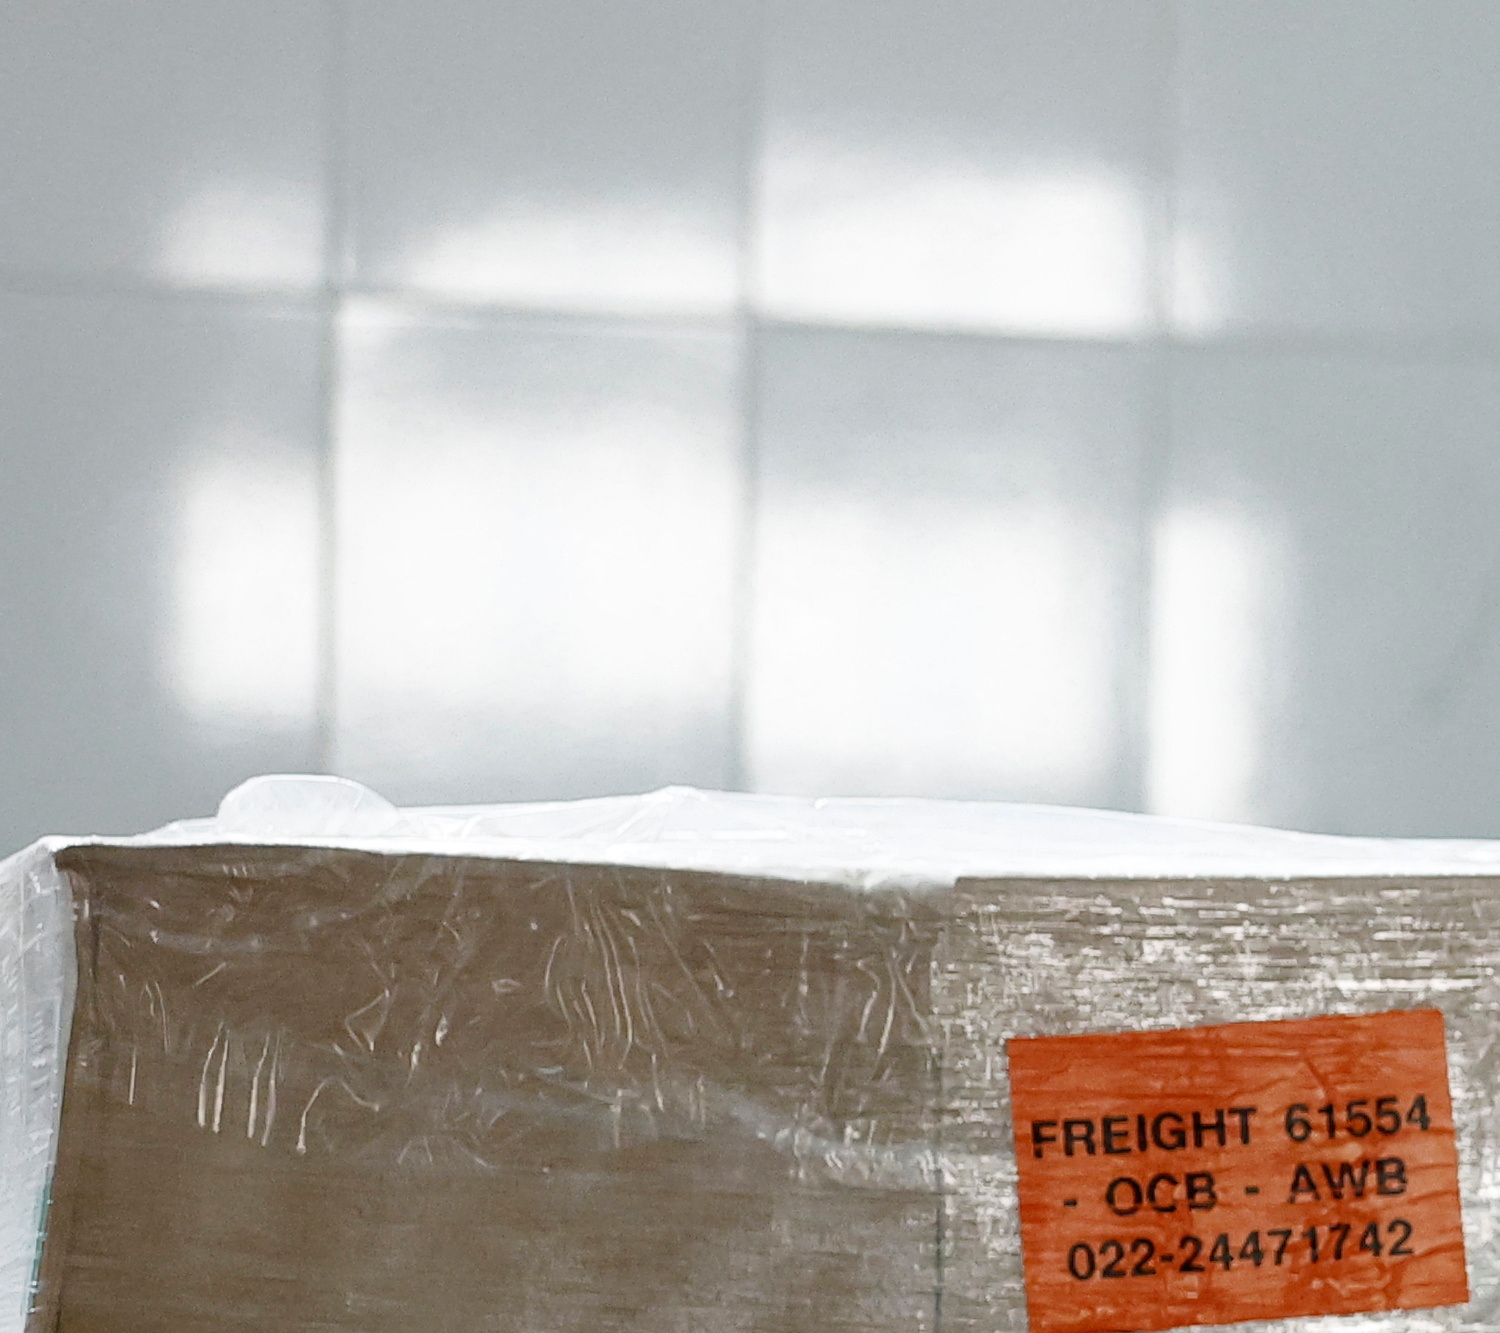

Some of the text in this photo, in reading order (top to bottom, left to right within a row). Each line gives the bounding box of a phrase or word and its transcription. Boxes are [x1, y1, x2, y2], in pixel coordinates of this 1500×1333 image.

[1030, 1094, 1431, 1158] FREIGHT 61554
[1105, 1171, 1218, 1216] OCB
[1288, 1157, 1408, 1204] AWB
[1067, 1219, 1415, 1281] 022-24471742
